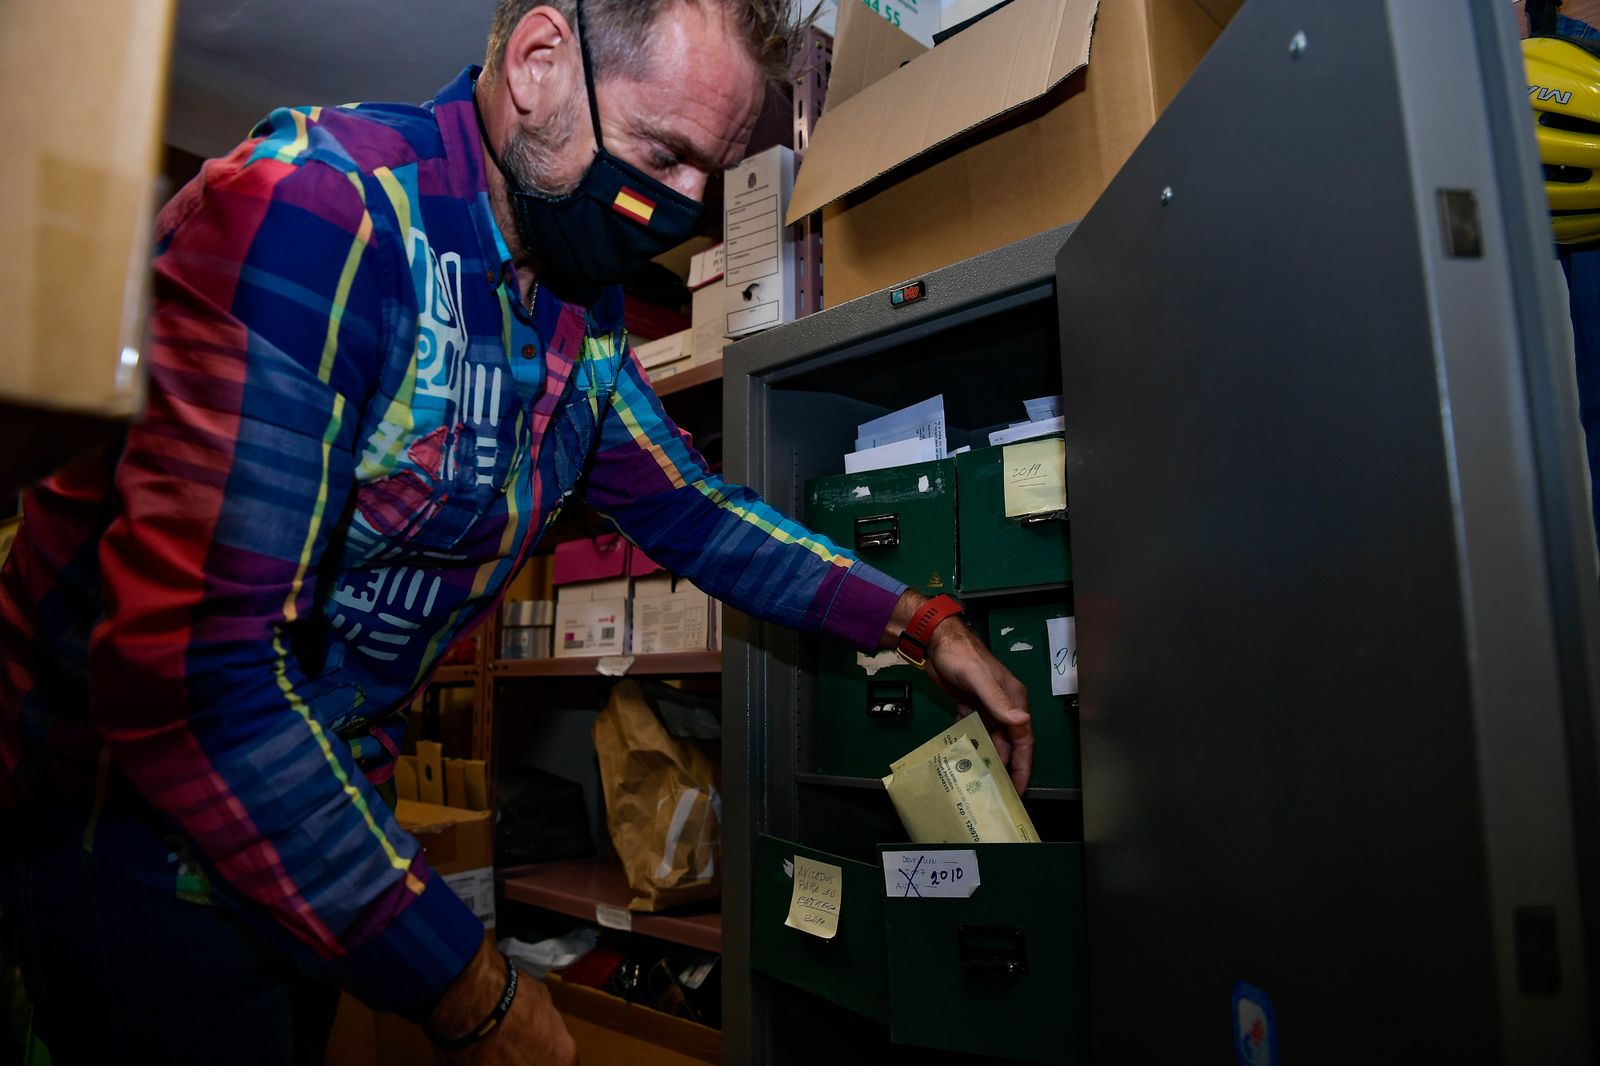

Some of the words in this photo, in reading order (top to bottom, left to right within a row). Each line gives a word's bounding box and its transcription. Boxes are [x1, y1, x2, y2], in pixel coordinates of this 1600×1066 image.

[885, 5, 900, 28] 55
[1012, 463, 1041, 478] 2019
[957, 802, 966, 816] Exp
[930, 867, 964, 886] 2010
